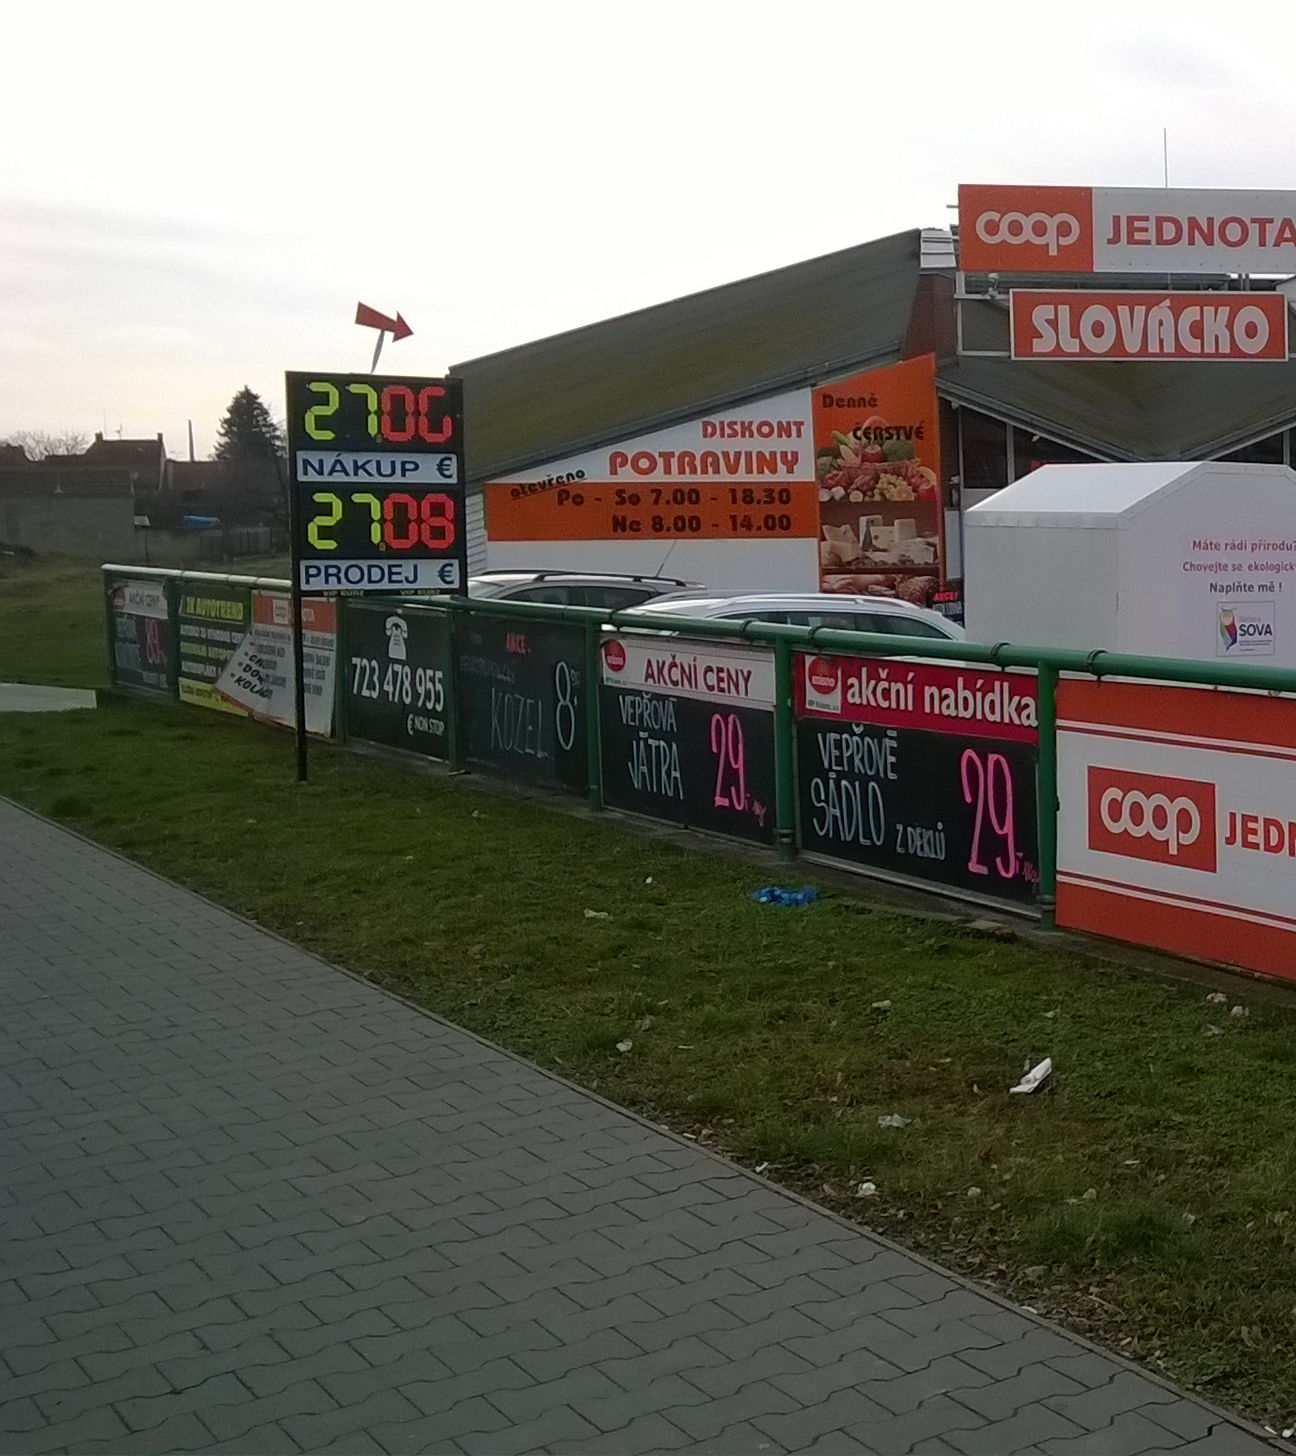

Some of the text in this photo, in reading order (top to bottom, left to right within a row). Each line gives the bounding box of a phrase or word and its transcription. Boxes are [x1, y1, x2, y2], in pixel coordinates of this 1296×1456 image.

[975, 211, 1081, 256] coop
[1031, 298, 1270, 354] SLOVÁCKO
[821, 392, 879, 409] Denně
[701, 420, 805, 439] DISKONT
[301, 453, 453, 479] NÁKUP €
[608, 450, 800, 476] POTRAVINY
[510, 467, 587, 499] otevřeno
[556, 489, 585, 506] Po
[614, 488, 642, 506] So
[650, 488, 701, 505] 7.00
[729, 488, 792, 505] 18.30
[611, 514, 642, 533] Ne
[651, 515, 702, 533] 8.00
[729, 514, 792, 532] 14.00
[1192, 539, 1221, 551] Máte
[1224, 539, 1248, 551] rádi
[303, 562, 455, 586] PRODEJ €
[1182, 560, 1229, 574] Chovejte
[1231, 563, 1243, 572] se
[1209, 580, 1255, 595] Naplňte
[1257, 581, 1276, 593] mě
[1238, 623, 1273, 637] SOVA
[352, 656, 380, 700] 723
[383, 662, 412, 706] 478
[416, 667, 445, 713] 955
[644, 653, 752, 697] AKČNÍ CENY
[846, 666, 1039, 728] akční nabídka
[618, 691, 678, 734] VEPŘOVÁ
[627, 731, 684, 801] JÁTRA
[817, 723, 898, 780] VEPŘOVÉ
[810, 771, 885, 846] SÁDLO
[1100, 786, 1201, 856] coop
